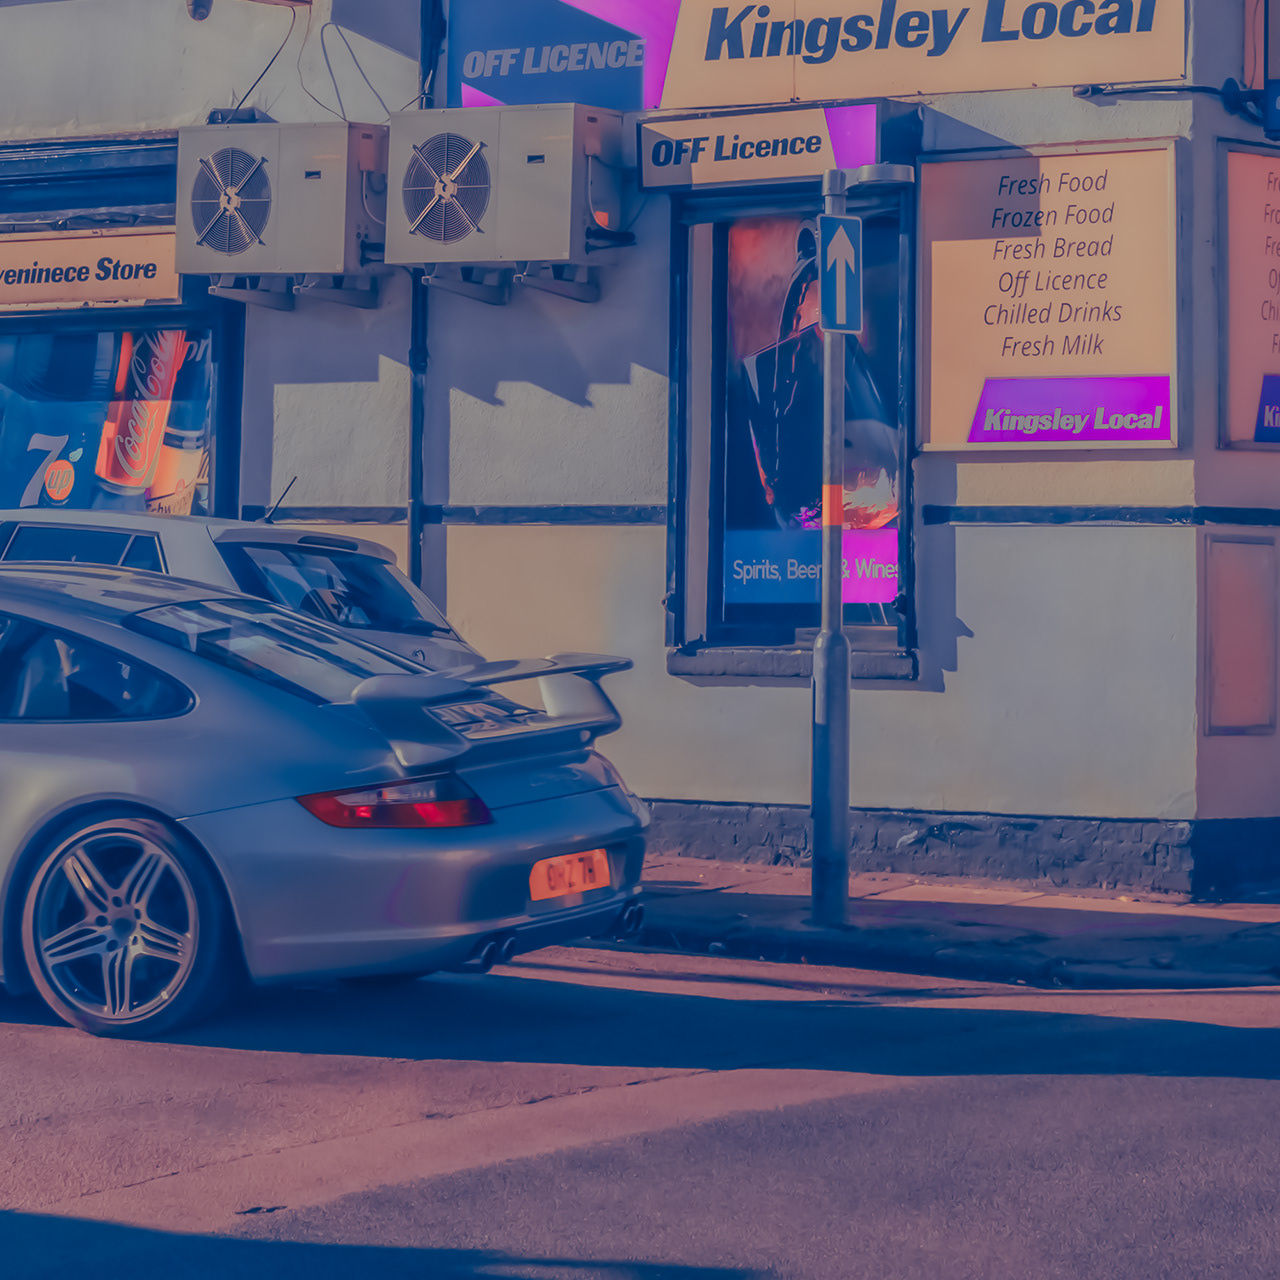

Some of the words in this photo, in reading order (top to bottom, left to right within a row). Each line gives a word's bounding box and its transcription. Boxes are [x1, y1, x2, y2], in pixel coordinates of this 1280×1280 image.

[462, 46, 516, 79] OFF
[522, 39, 645, 75] LICENCE
[652, 135, 708, 167] OFF
[713, 133, 822, 163] Licence
[998, 173, 1051, 196] Fresh
[1058, 169, 1108, 193] Food
[992, 208, 1057, 228] Frozen
[1065, 202, 1114, 225] Food
[993, 238, 1045, 260] Fresh
[1053, 234, 1114, 258] Bread
[95, 257, 157, 281] Store
[999, 270, 1031, 298] Off
[1035, 270, 1108, 291] Licence
[984, 302, 1052, 325] Chilled
[1058, 300, 1122, 323] Drinks
[1002, 335, 1054, 356] Fresh
[1062, 333, 1104, 355] Milk
[984, 408, 1090, 434] Kingsley
[1094, 405, 1162, 430] Local
[733, 559, 782, 585] Spirits,
[787, 559, 823, 579] Beer
